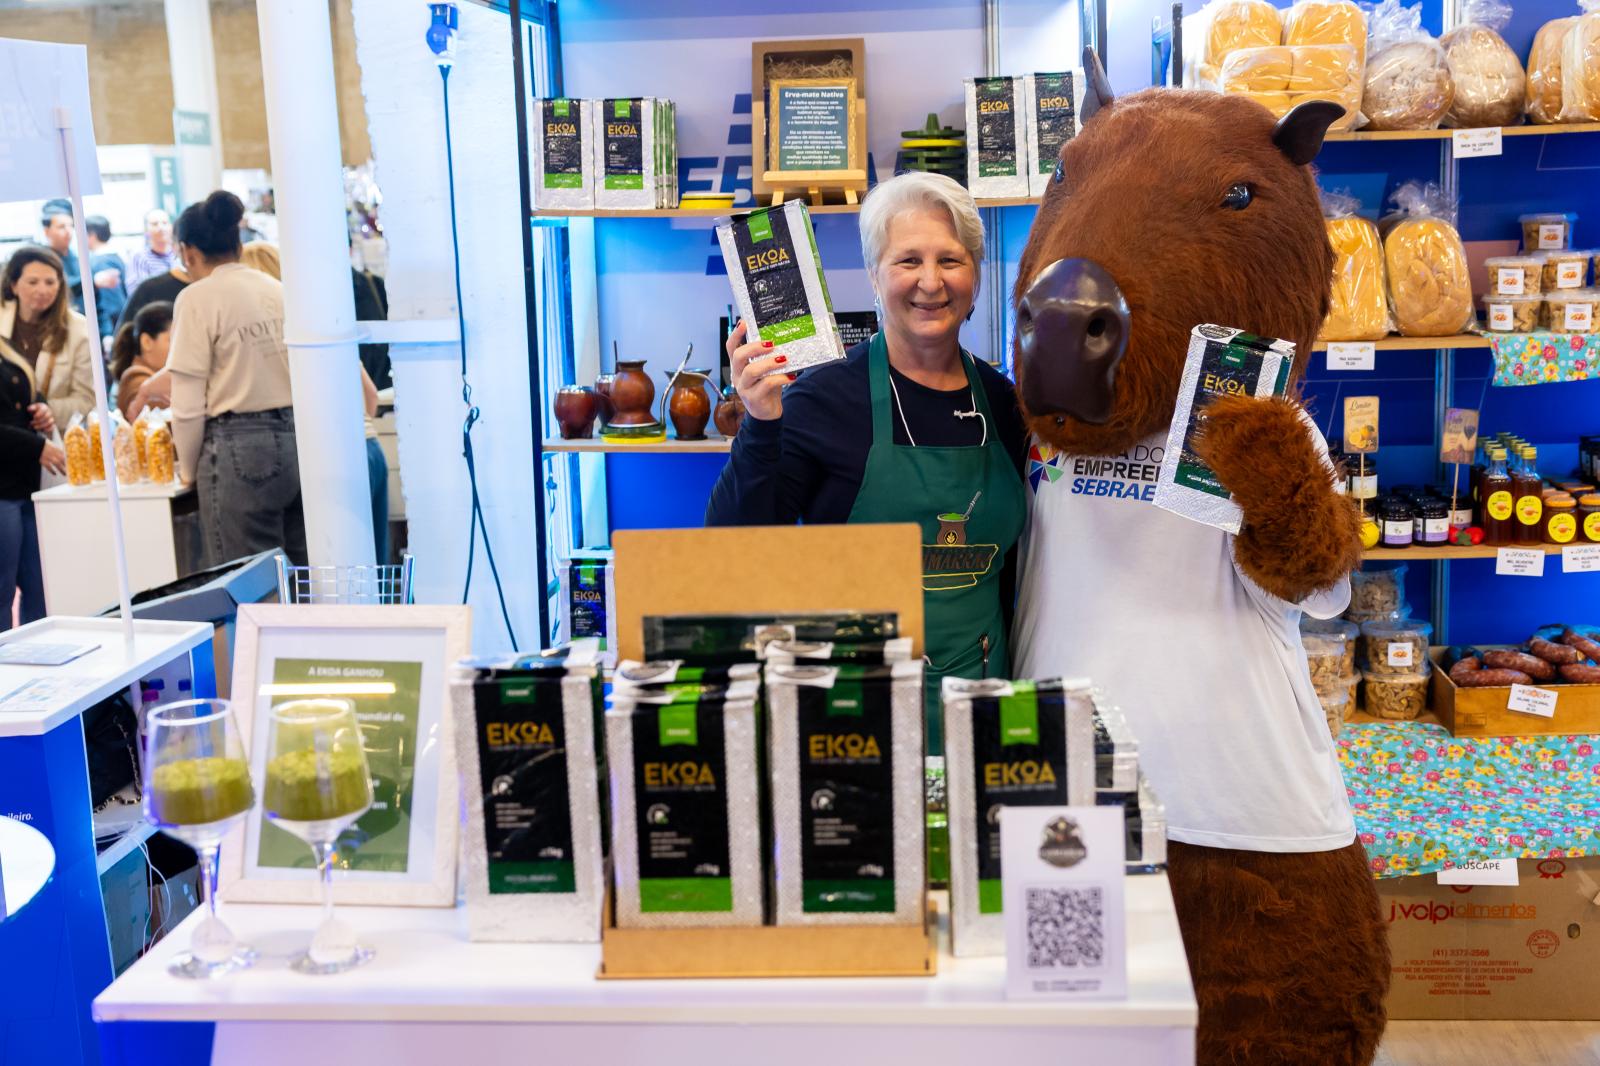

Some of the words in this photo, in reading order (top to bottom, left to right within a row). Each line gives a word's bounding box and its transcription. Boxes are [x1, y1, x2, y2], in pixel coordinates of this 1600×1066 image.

[980, 101, 1009, 112] EKOA
[1039, 96, 1069, 107] EKOA
[547, 123, 577, 134] EKOA
[608, 124, 637, 134] EKOA
[746, 247, 790, 270] EKOA
[1204, 374, 1247, 396] EKOA
[1071, 477, 1157, 502] SEBRAE
[574, 590, 602, 601] EKOA
[486, 720, 555, 745] EKOA
[808, 733, 881, 758] EKOA
[644, 760, 716, 786] EKOA
[984, 760, 1057, 786] EKOA
